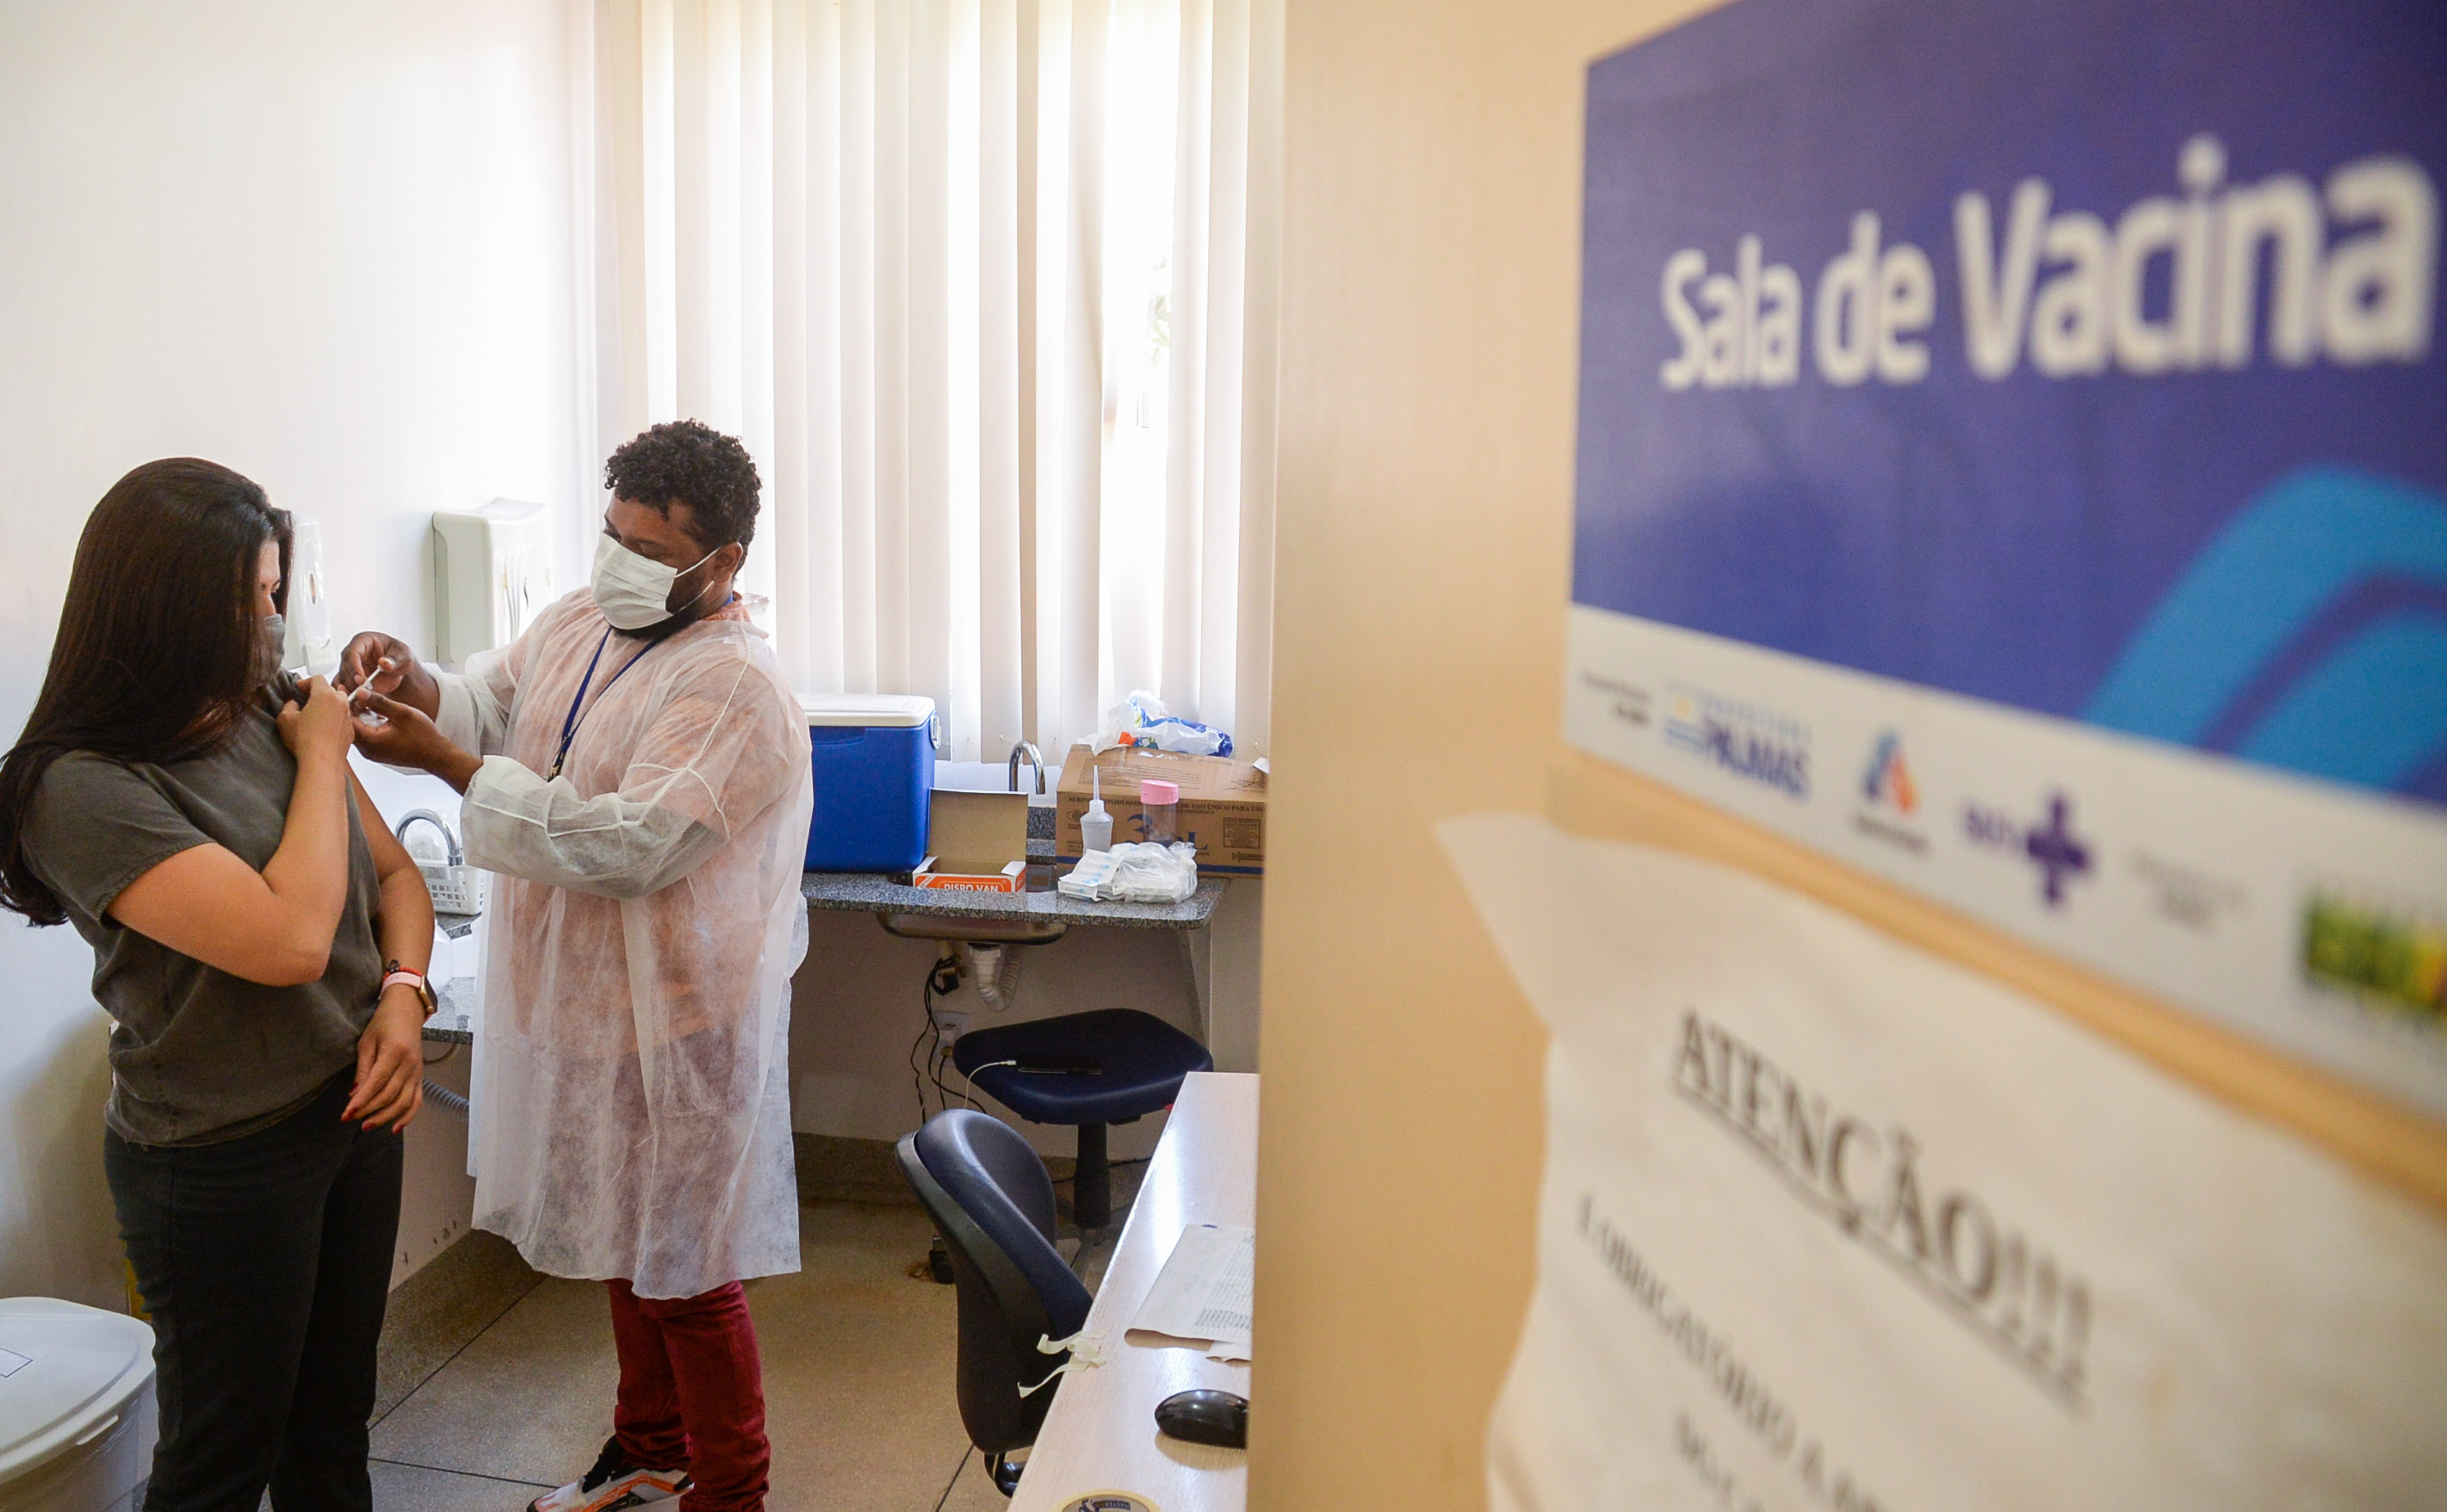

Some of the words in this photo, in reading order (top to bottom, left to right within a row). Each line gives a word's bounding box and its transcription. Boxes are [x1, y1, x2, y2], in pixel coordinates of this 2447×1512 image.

[1659, 231, 1802, 393] Sala
[1814, 208, 1937, 387] de
[1952, 131, 2442, 382] Vacina
[976, 883, 999, 893] VAN
[1674, 1007, 2096, 1385] ATENÇÃO!!!
